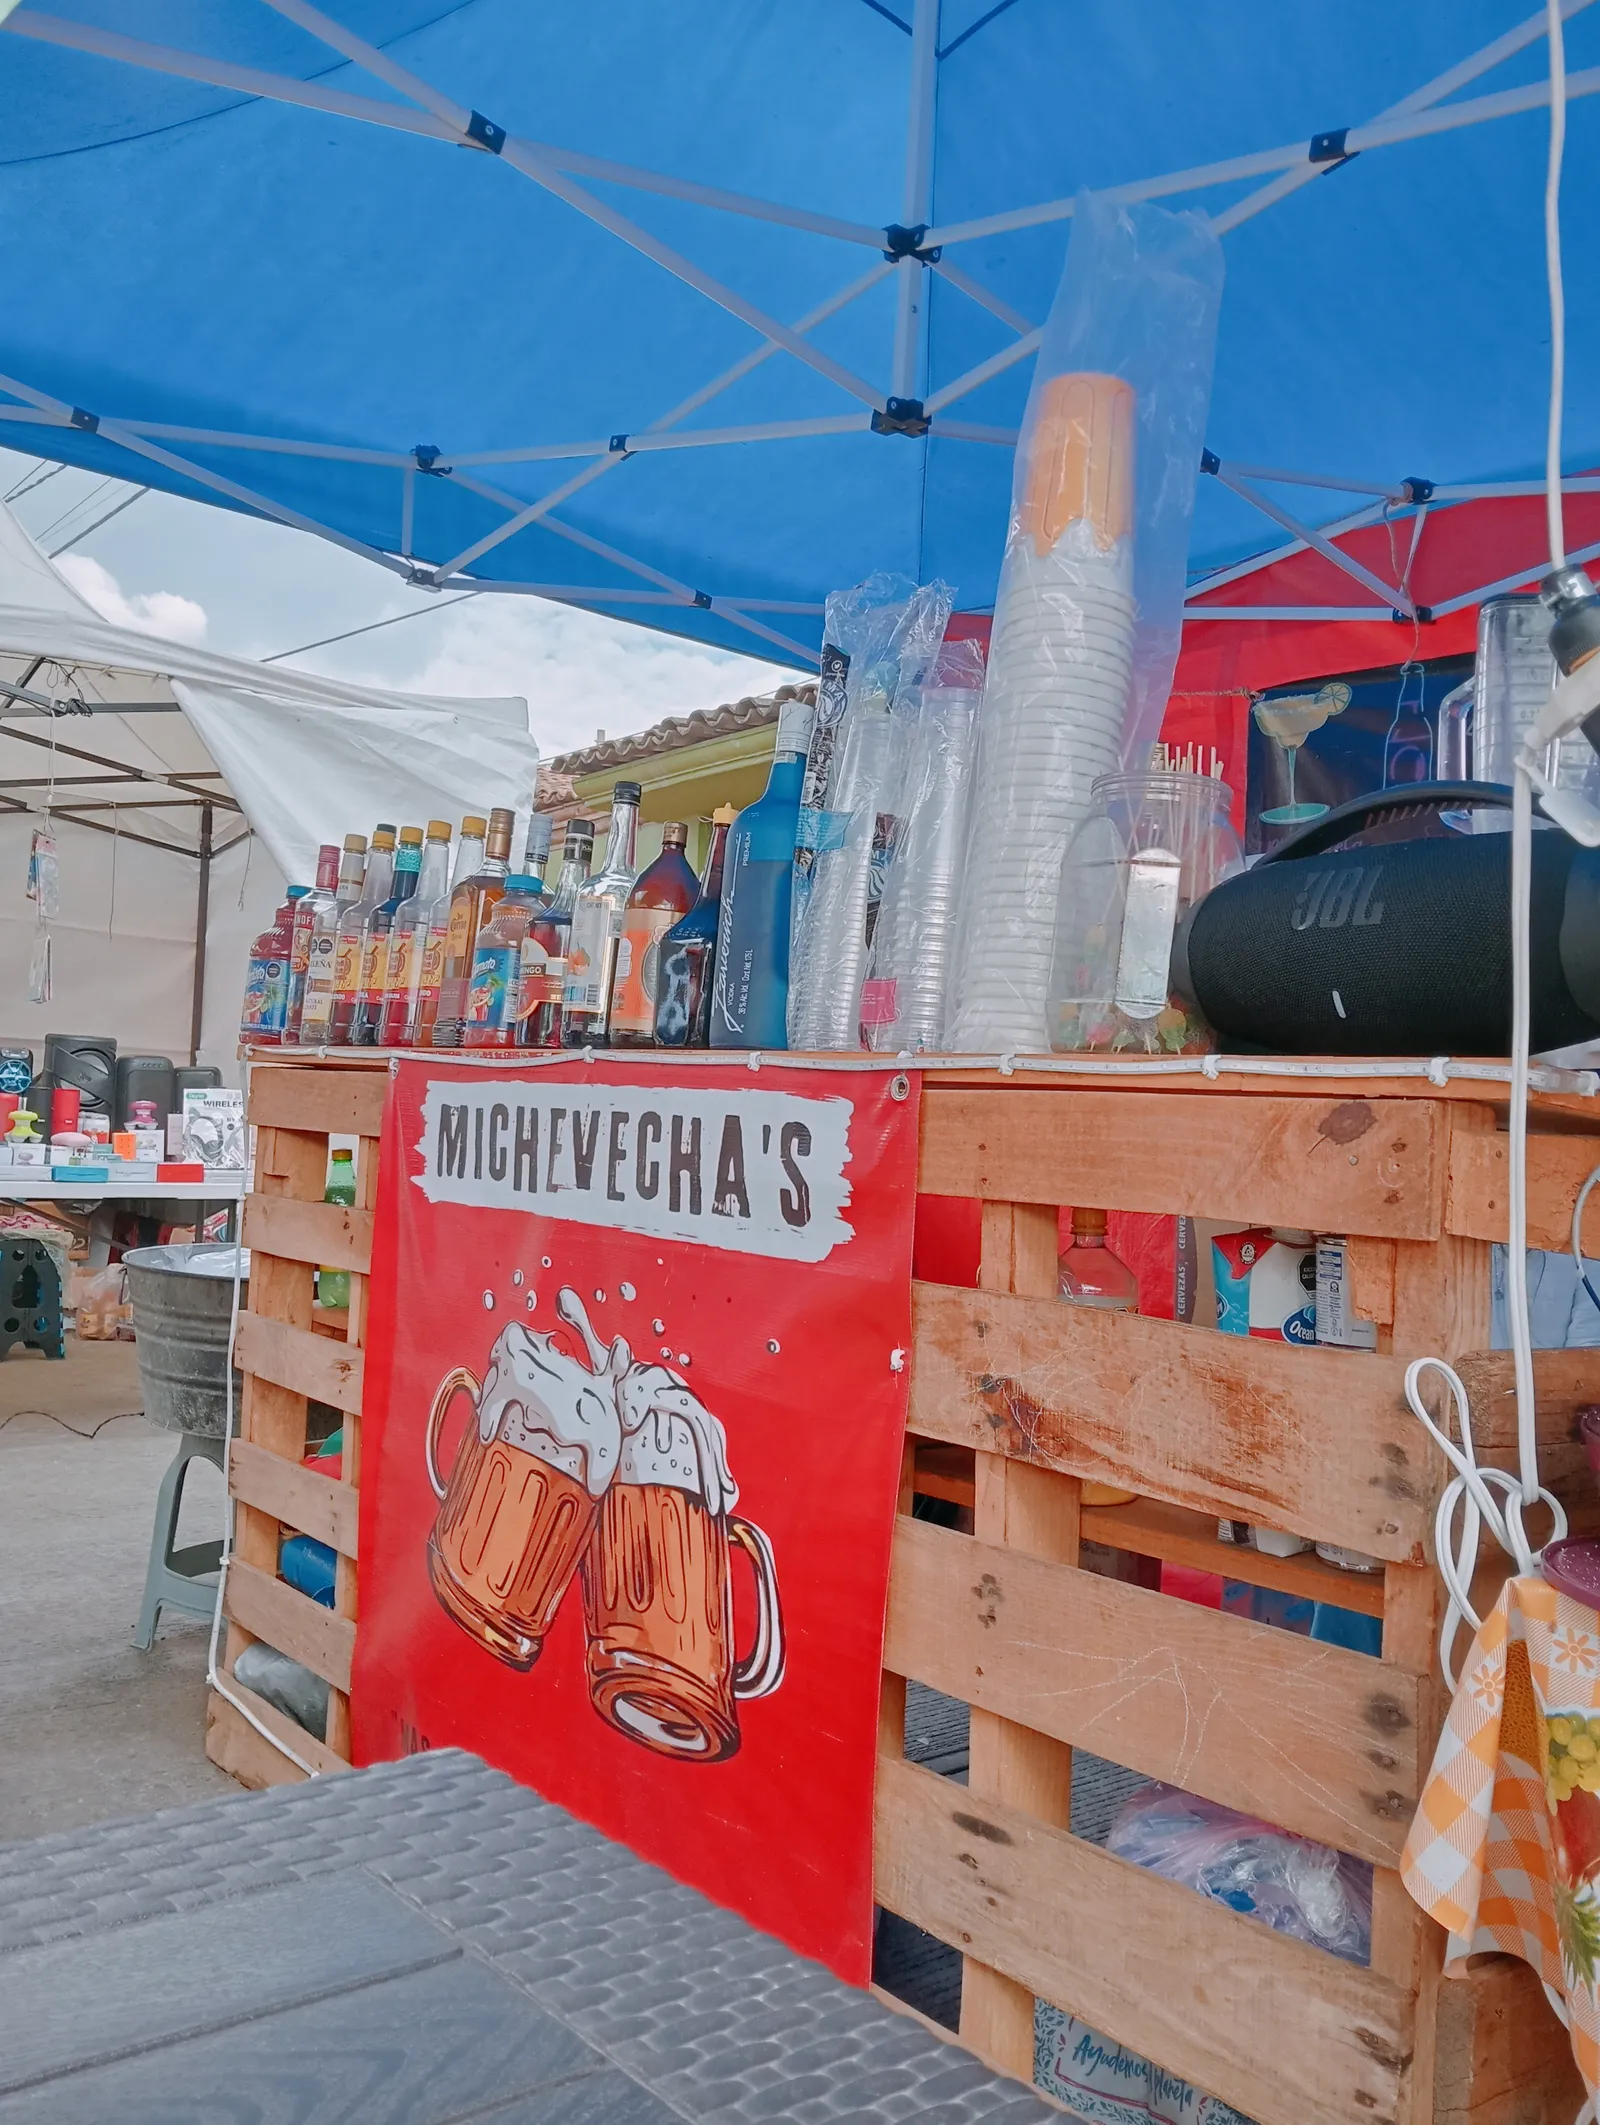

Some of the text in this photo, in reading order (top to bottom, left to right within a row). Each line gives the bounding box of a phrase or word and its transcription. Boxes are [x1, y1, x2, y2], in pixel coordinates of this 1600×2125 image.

[742, 832, 752, 867] PREMIUM
[1291, 866, 1384, 930] JBL
[727, 982, 735, 1006] VODKA
[437, 1103, 811, 1228] MICHEVECHA'S
[1178, 1266, 1186, 1315] CERVEZAS
[1289, 1320, 1315, 1341] Ocean
